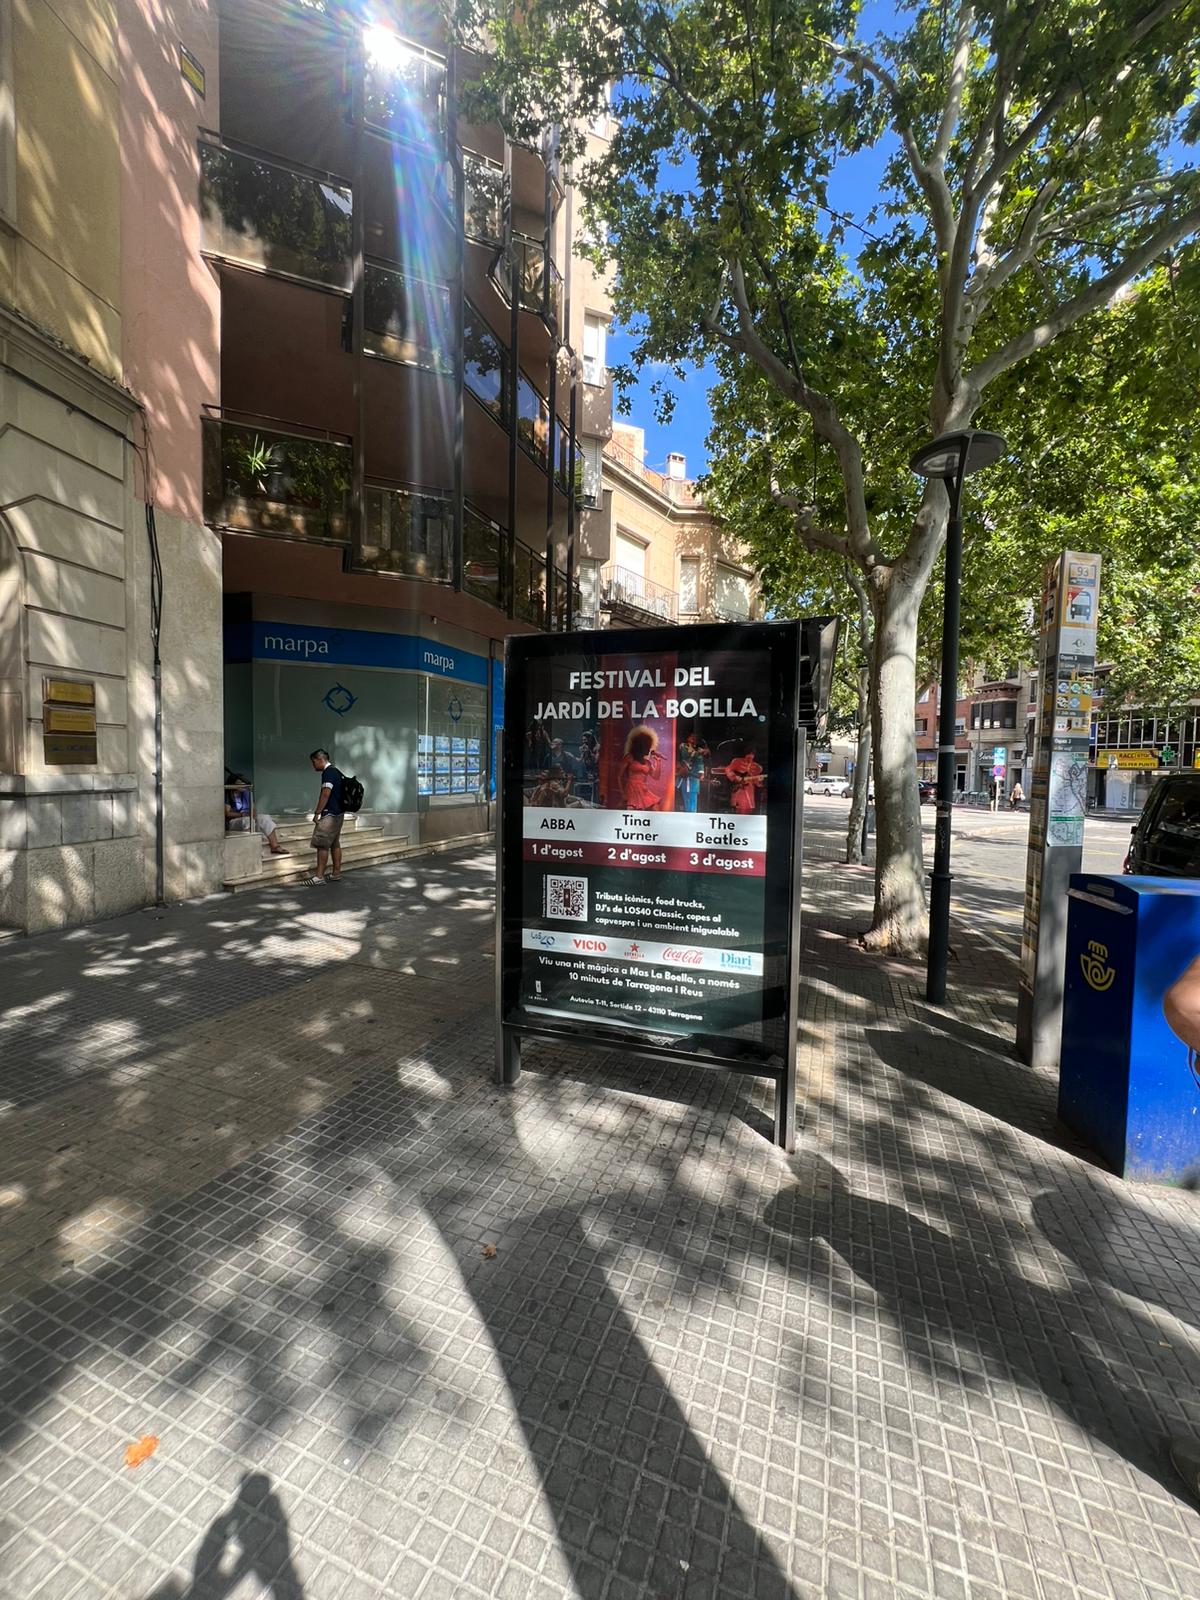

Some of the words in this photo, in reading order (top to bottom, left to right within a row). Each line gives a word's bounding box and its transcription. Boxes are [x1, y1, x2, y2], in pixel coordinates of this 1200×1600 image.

[264, 634, 329, 658] marpa
[424, 651, 454, 672] marpa
[569, 668, 666, 689] FESTIVAL
[674, 666, 716, 687] DEL
[534, 696, 592, 719] JARDÍ
[597, 701, 624, 719] DE
[631, 700, 660, 718] LA
[666, 698, 766, 722] BOELLA.
[540, 818, 575, 830] ABBA
[622, 814, 651, 827] Tina
[709, 817, 735, 830] The
[615, 828, 659, 842] Turner
[696, 832, 749, 846] Beatles
[532, 844, 537, 854] 1
[540, 844, 583, 859] d'agost
[608, 848, 616, 860] 2
[620, 849, 666, 865] d'agost
[690, 853, 699, 865] 3
[703, 853, 754, 871] d'agost
[595, 891, 623, 902] Tributs
[656, 896, 675, 907] food
[676, 898, 705, 910] trucks,
[595, 903, 611, 913] DJ's
[612, 904, 623, 914] de
[624, 906, 651, 916] LOS40
[653, 909, 685, 920] Classic,
[686, 913, 711, 924] copes
[712, 914, 721, 923] al
[595, 916, 635, 929] capvespre
[654, 921, 689, 932] ambient
[690, 923, 740, 938] inigualable
[573, 939, 607, 951] VICIO
[721, 952, 752, 966] Diari
[539, 956, 553, 966] Viu
[555, 958, 572, 967] una
[573, 960, 585, 970] nit
[587, 961, 620, 975] màgica
[629, 966, 650, 977] Mas
[651, 969, 663, 979] La
[664, 970, 697, 985] Boella,
[699, 976, 706, 985] a
[707, 977, 740, 989] només
[569, 972, 579, 981] 10
[612, 978, 624, 987] de
[625, 979, 673, 994] Tarragona
[675, 983, 679, 994] i
[680, 986, 703, 998] Reus
[570, 995, 594, 1004] Autovia
[610, 1001, 633, 1010] Sortida
[667, 1010, 703, 1020] Tarragona
